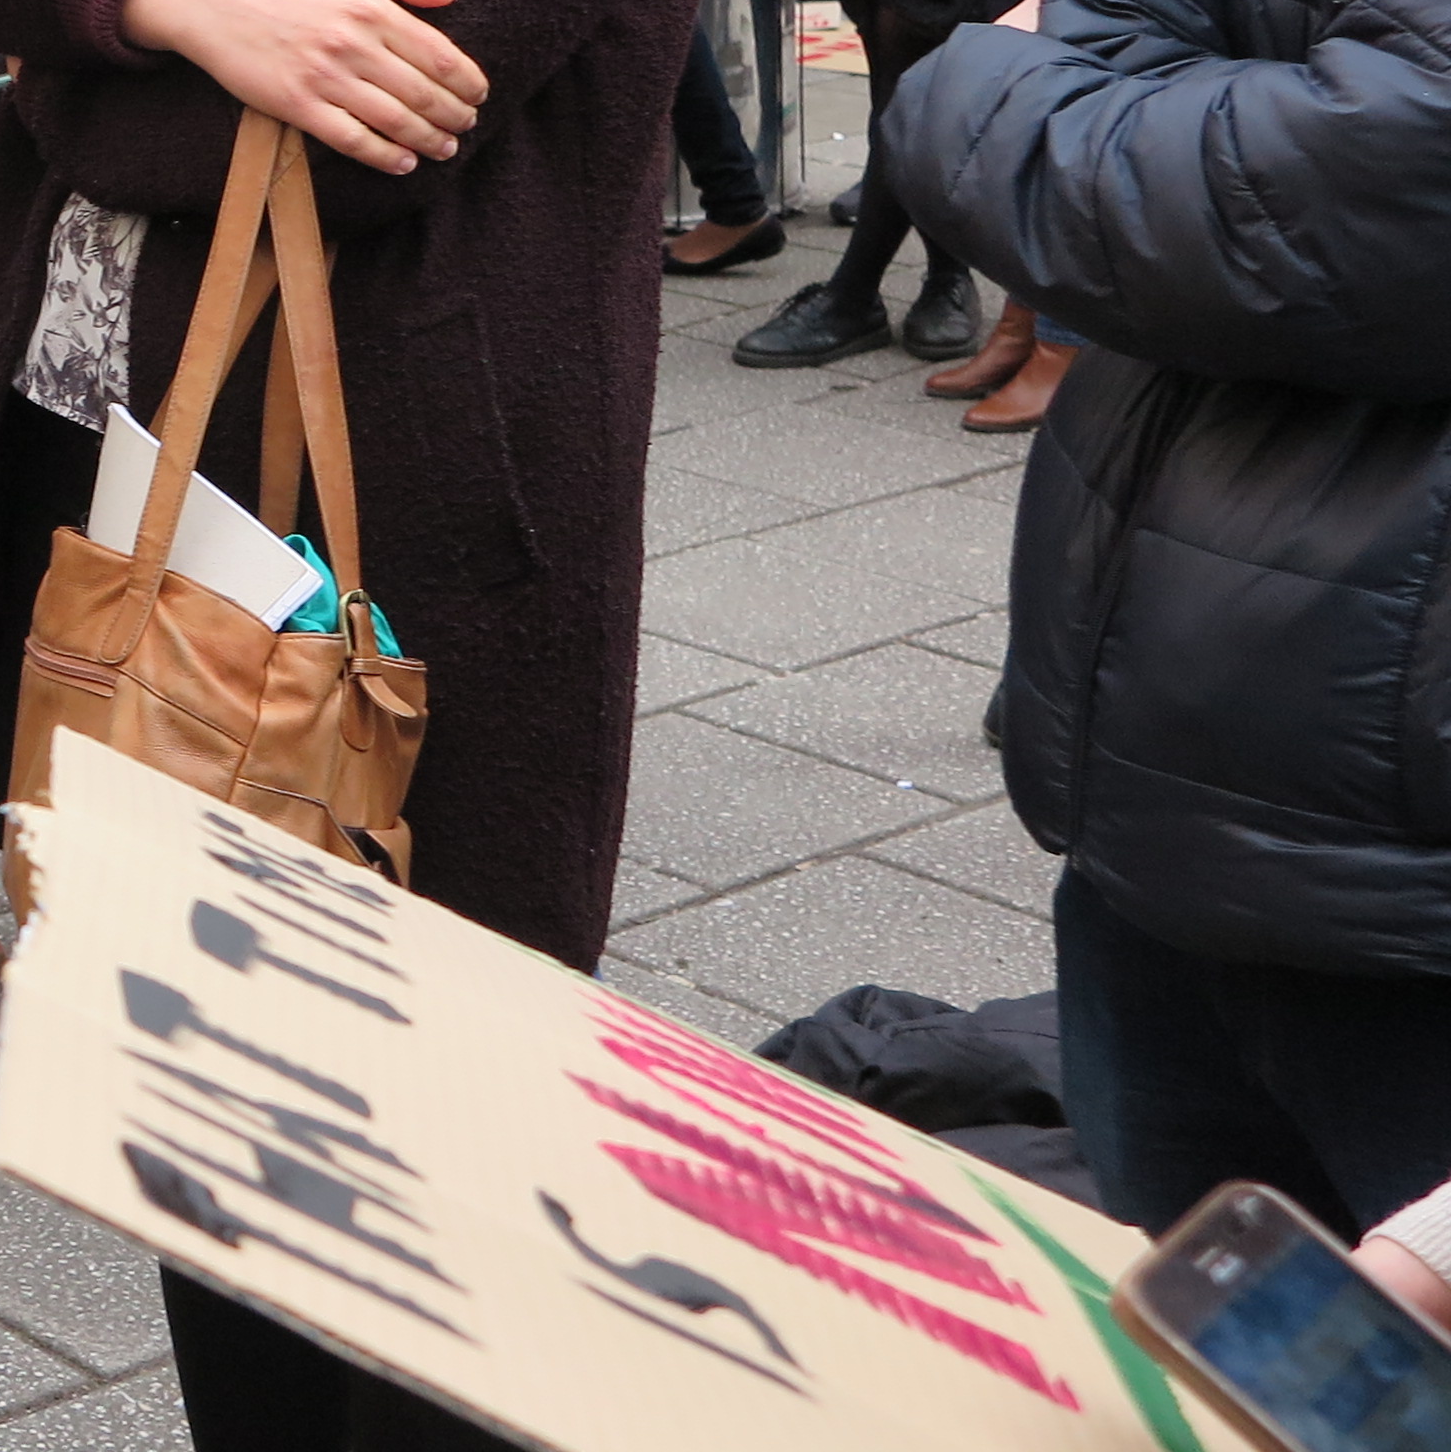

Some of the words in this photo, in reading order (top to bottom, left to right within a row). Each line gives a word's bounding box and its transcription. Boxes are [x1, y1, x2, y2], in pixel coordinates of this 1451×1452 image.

[187, 808, 415, 1028] TIME
[117, 967, 487, 1351] THAT
[534, 1186, 825, 1408] IS
